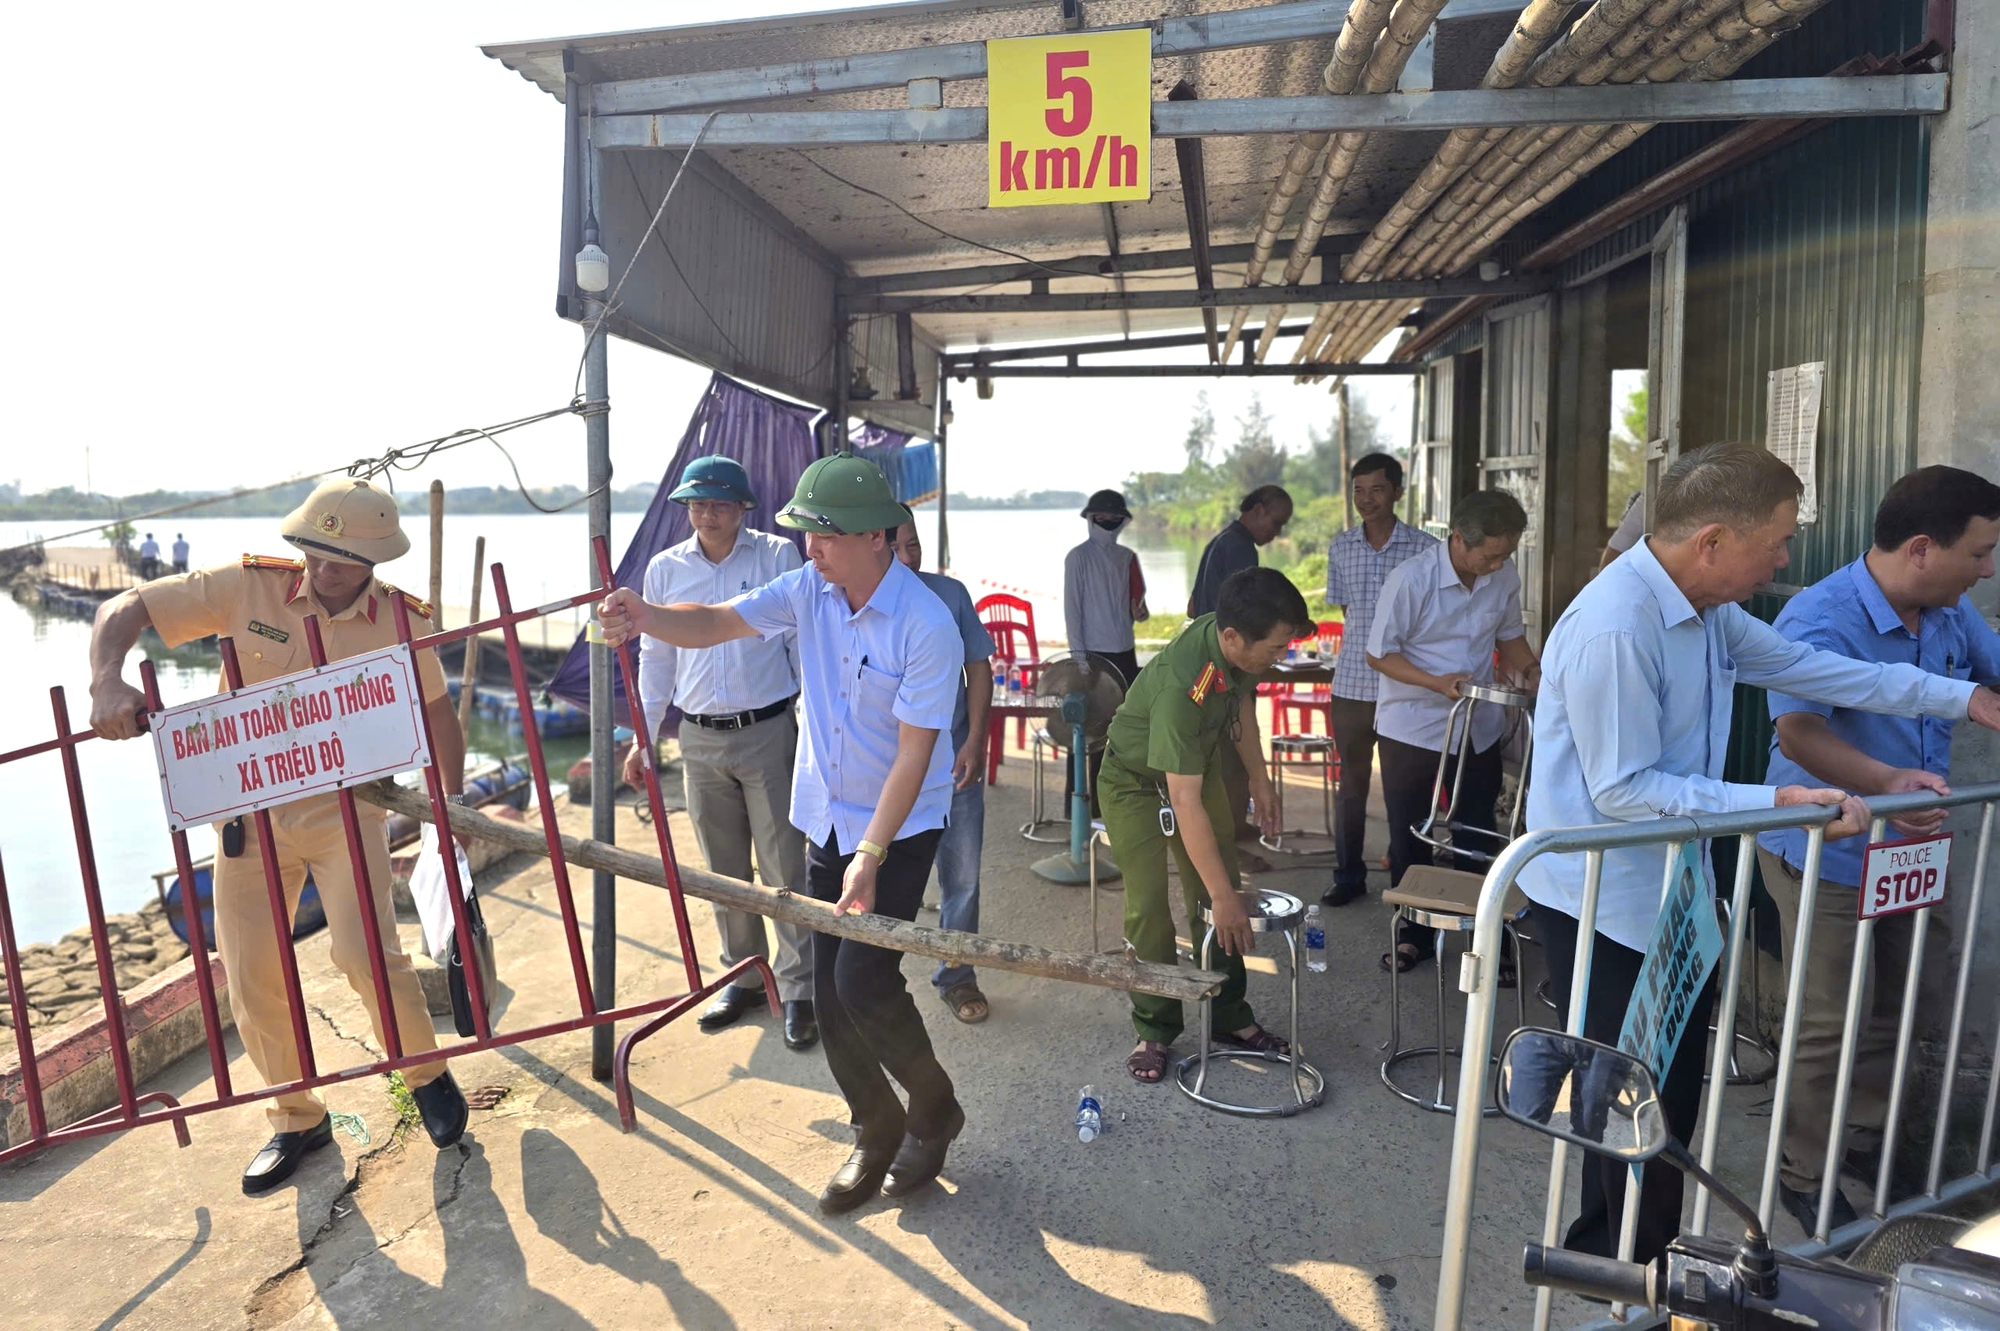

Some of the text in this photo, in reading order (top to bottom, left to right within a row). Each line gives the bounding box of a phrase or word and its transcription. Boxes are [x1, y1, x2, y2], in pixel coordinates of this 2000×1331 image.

[1045, 50, 1093, 138] 5
[1000, 135, 1138, 192] km/h
[172, 722, 211, 760] BAN
[214, 715, 239, 750] AN
[240, 699, 288, 742] TOÀN
[290, 689, 332, 729] GIAO
[237, 731, 345, 793] XÃ TRIỆU ĐỘ
[1875, 867, 1938, 907] STOP
[1889, 846, 1932, 868] POLICE
[1648, 866, 1696, 1002] PHAO
[1666, 950, 1704, 1048] ĐỘNG
